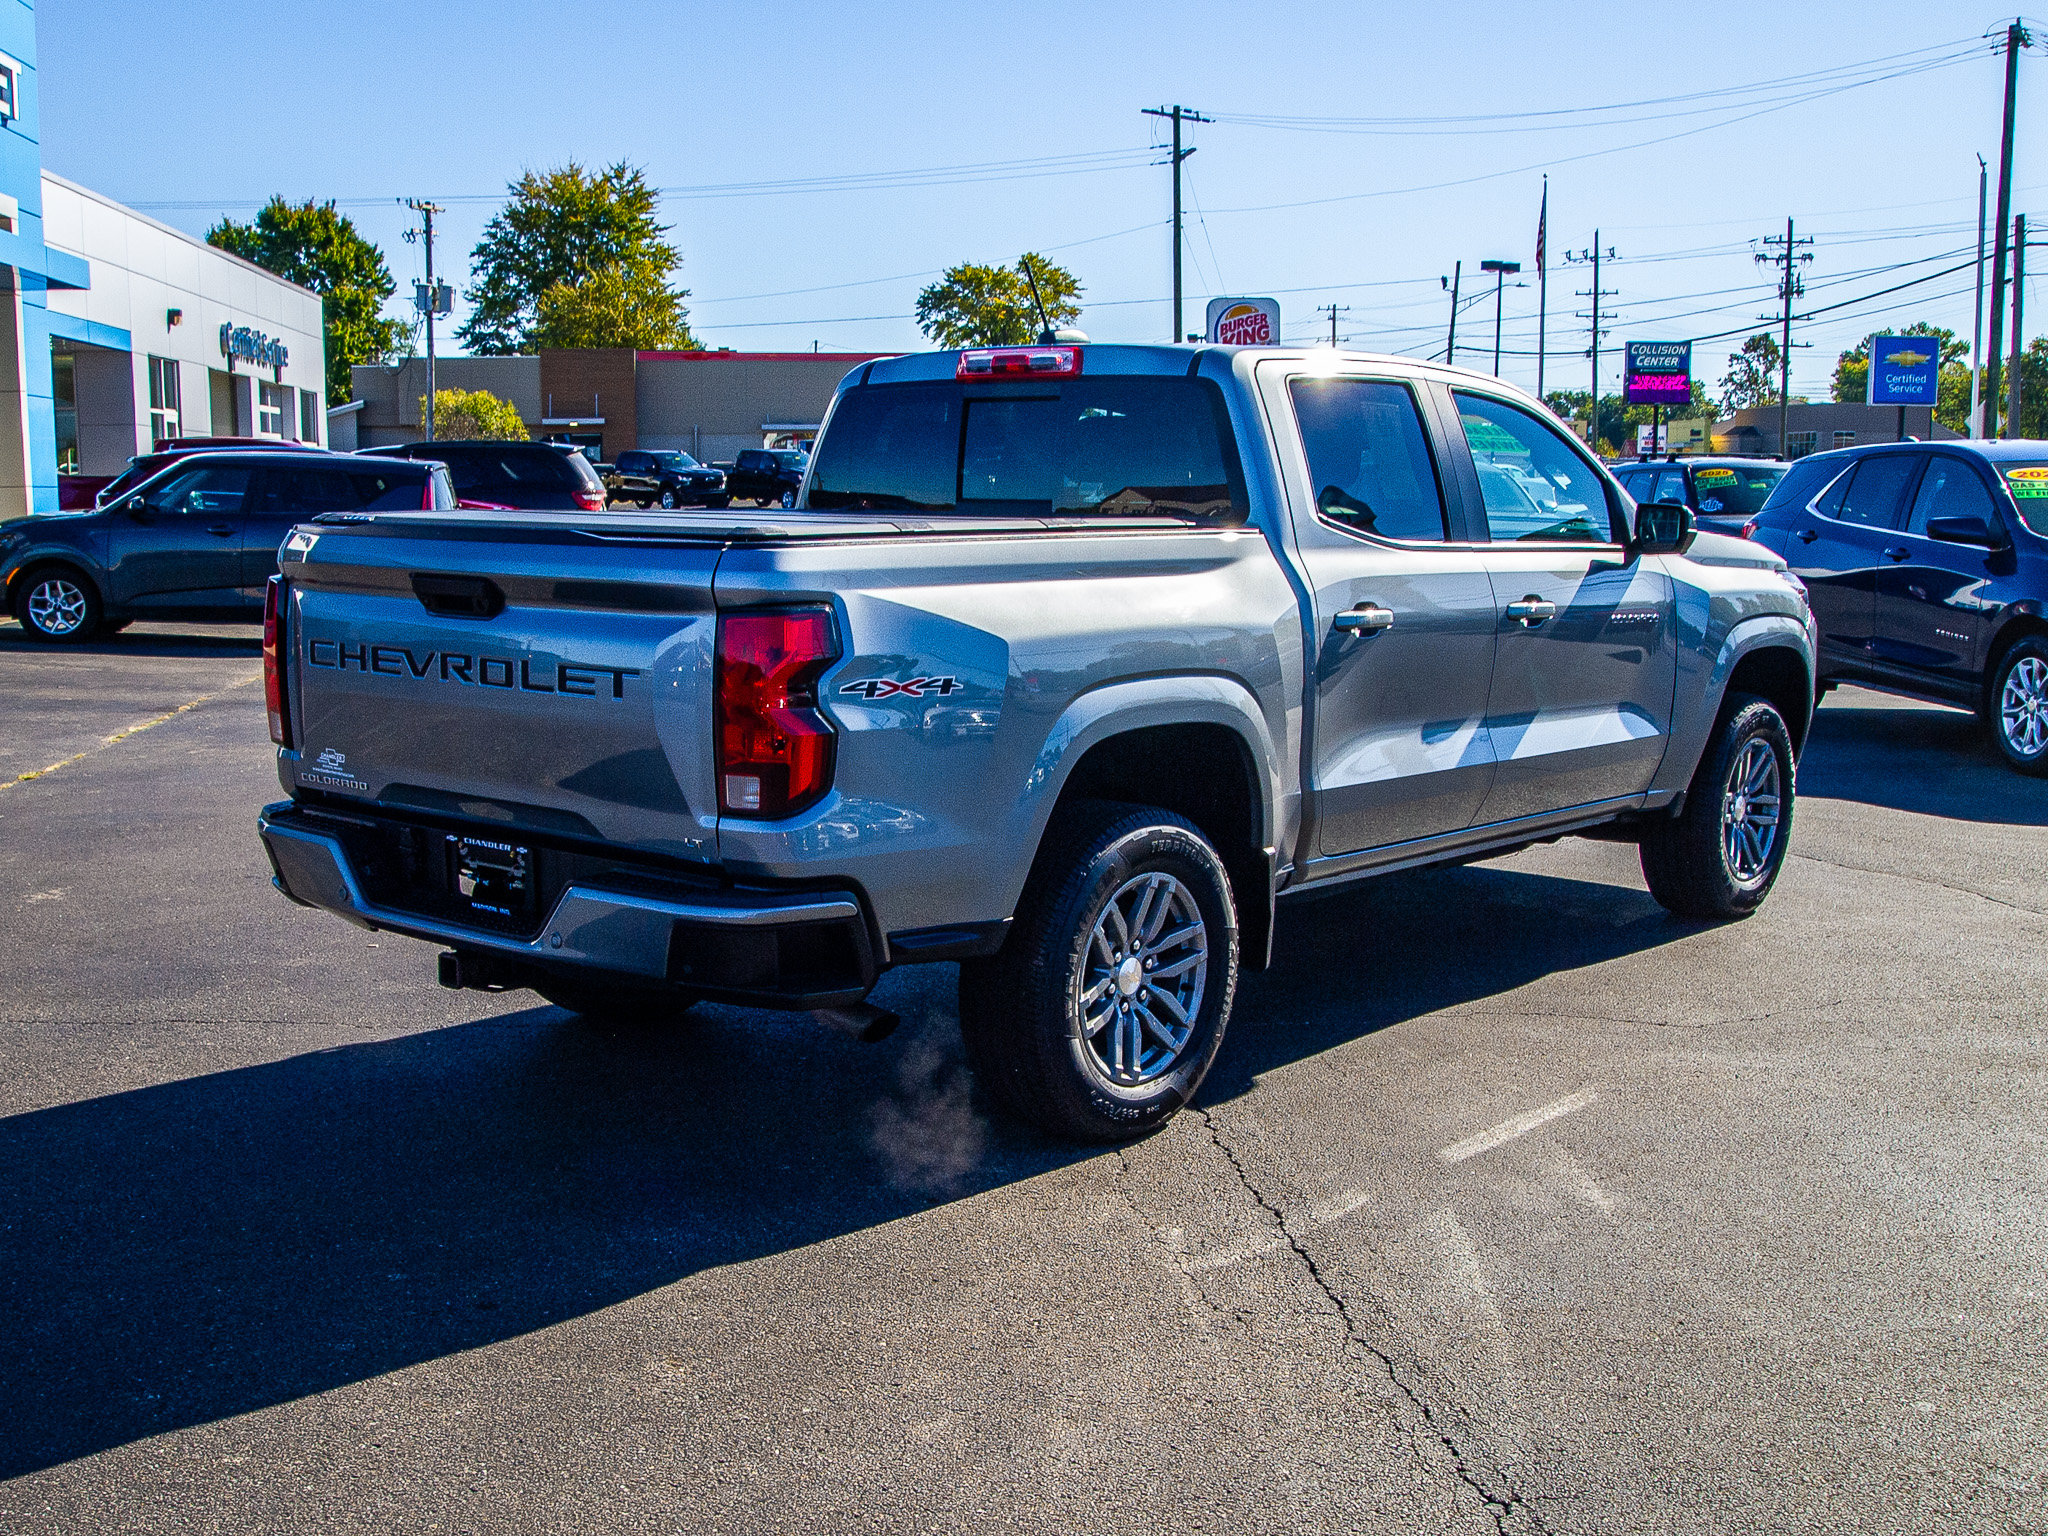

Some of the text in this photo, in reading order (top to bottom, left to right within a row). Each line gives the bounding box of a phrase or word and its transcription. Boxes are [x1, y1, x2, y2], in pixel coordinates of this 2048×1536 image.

[1220, 313, 1268, 337] BURGER
[1222, 325, 1270, 345] KING
[1631, 344, 1687, 355] COLLISION
[1636, 356, 1679, 366] CENTER
[1885, 374, 1927, 384] Certified
[1888, 384, 1923, 393] Service
[308, 638, 641, 702] CHEVROLET
[301, 772, 368, 791] COLORADO
[463, 837, 511, 852] CHANDLER
[684, 837, 703, 849] LT
